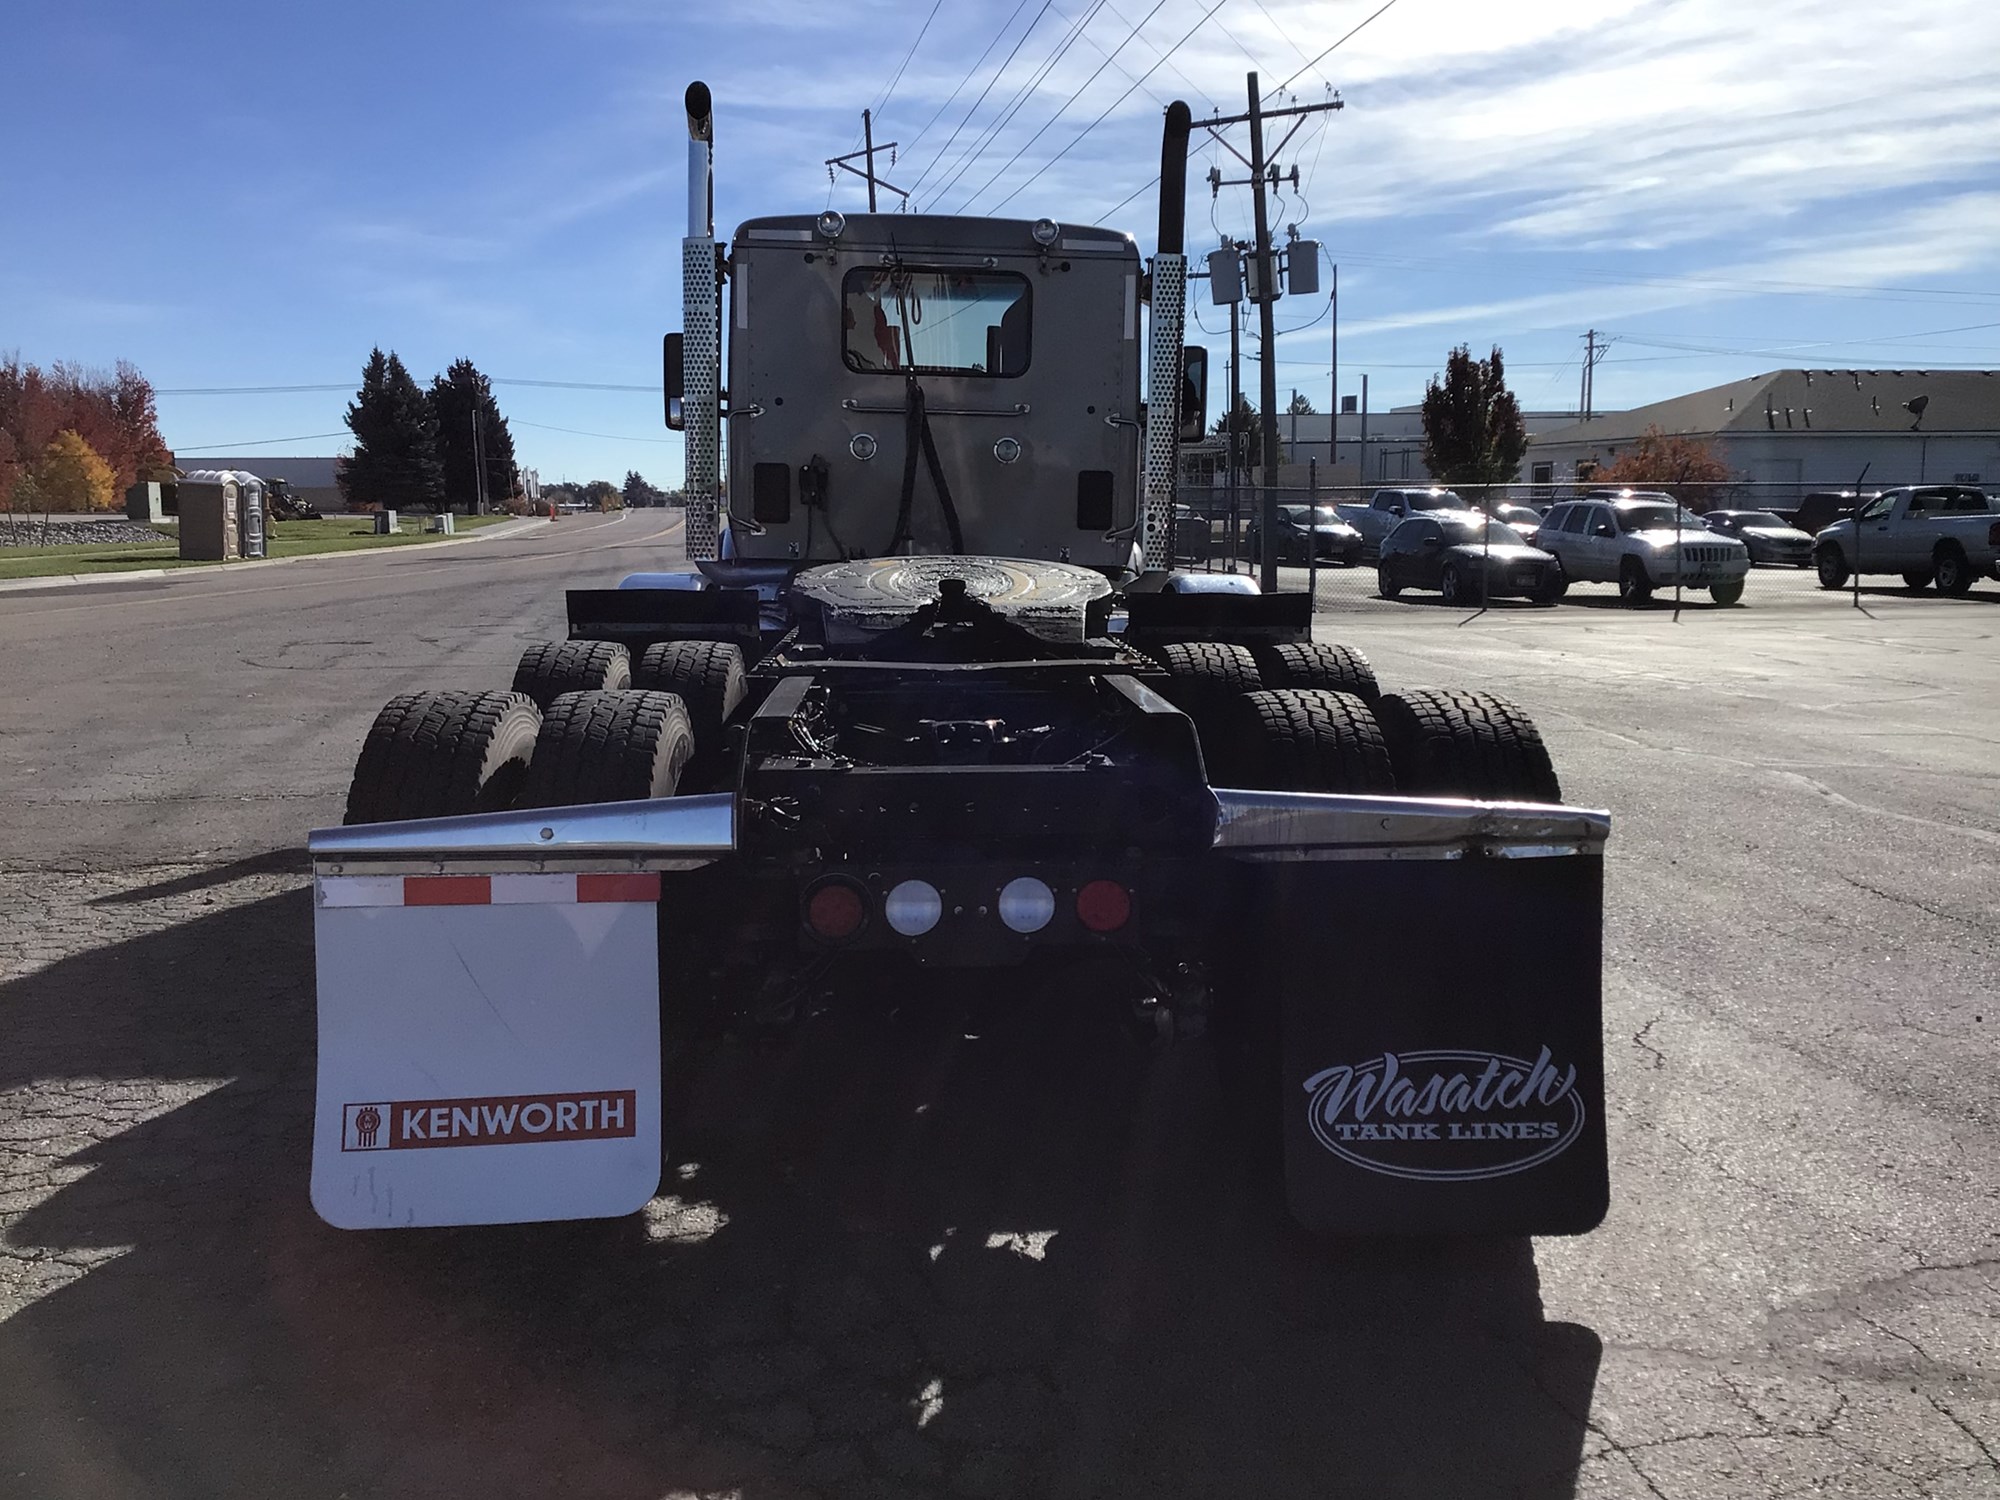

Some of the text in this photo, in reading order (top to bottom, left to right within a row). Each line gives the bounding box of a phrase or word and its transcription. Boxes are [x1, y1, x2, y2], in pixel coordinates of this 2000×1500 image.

[1303, 1045, 1577, 1124] Wasatch
[402, 1098, 625, 1140] KENWORTH
[1335, 1121, 1560, 1141] TANK LINES
